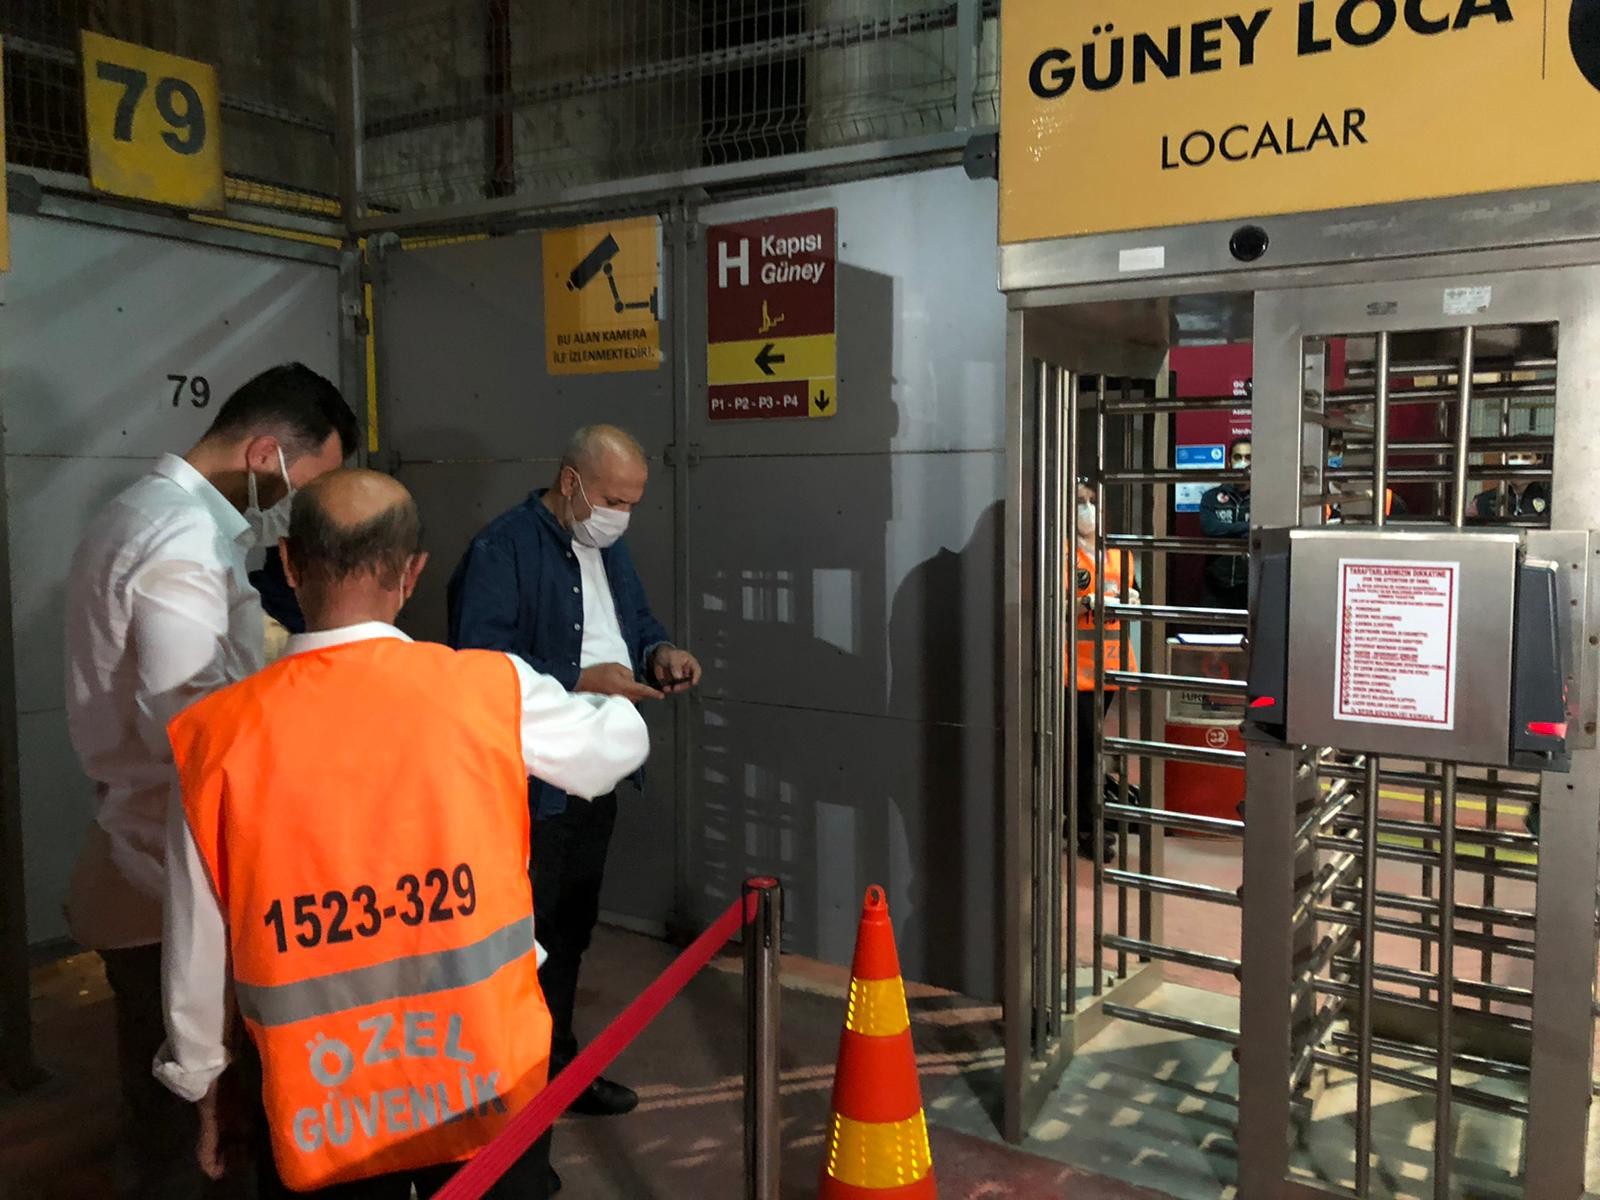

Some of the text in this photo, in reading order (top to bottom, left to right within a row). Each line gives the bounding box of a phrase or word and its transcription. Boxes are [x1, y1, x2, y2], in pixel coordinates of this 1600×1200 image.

[1028, 9, 1270, 99] GÜNEY
[96, 60, 208, 155] 79
[1161, 107, 1368, 170] LOCALAR
[718, 238, 749, 288] H
[761, 233, 823, 258] Kapısı
[761, 262, 826, 285] Güney
[556, 327, 648, 346] BU ALAN KAMERA
[167, 375, 211, 409] 79
[711, 397, 724, 411] P1
[734, 396, 750, 410] P2
[758, 395, 774, 409] P3
[783, 394, 798, 408] P4
[264, 862, 477, 954] 1523-329
[304, 1011, 475, 1088] ÖZEL
[293, 1066, 508, 1153] GÜVENLİK
